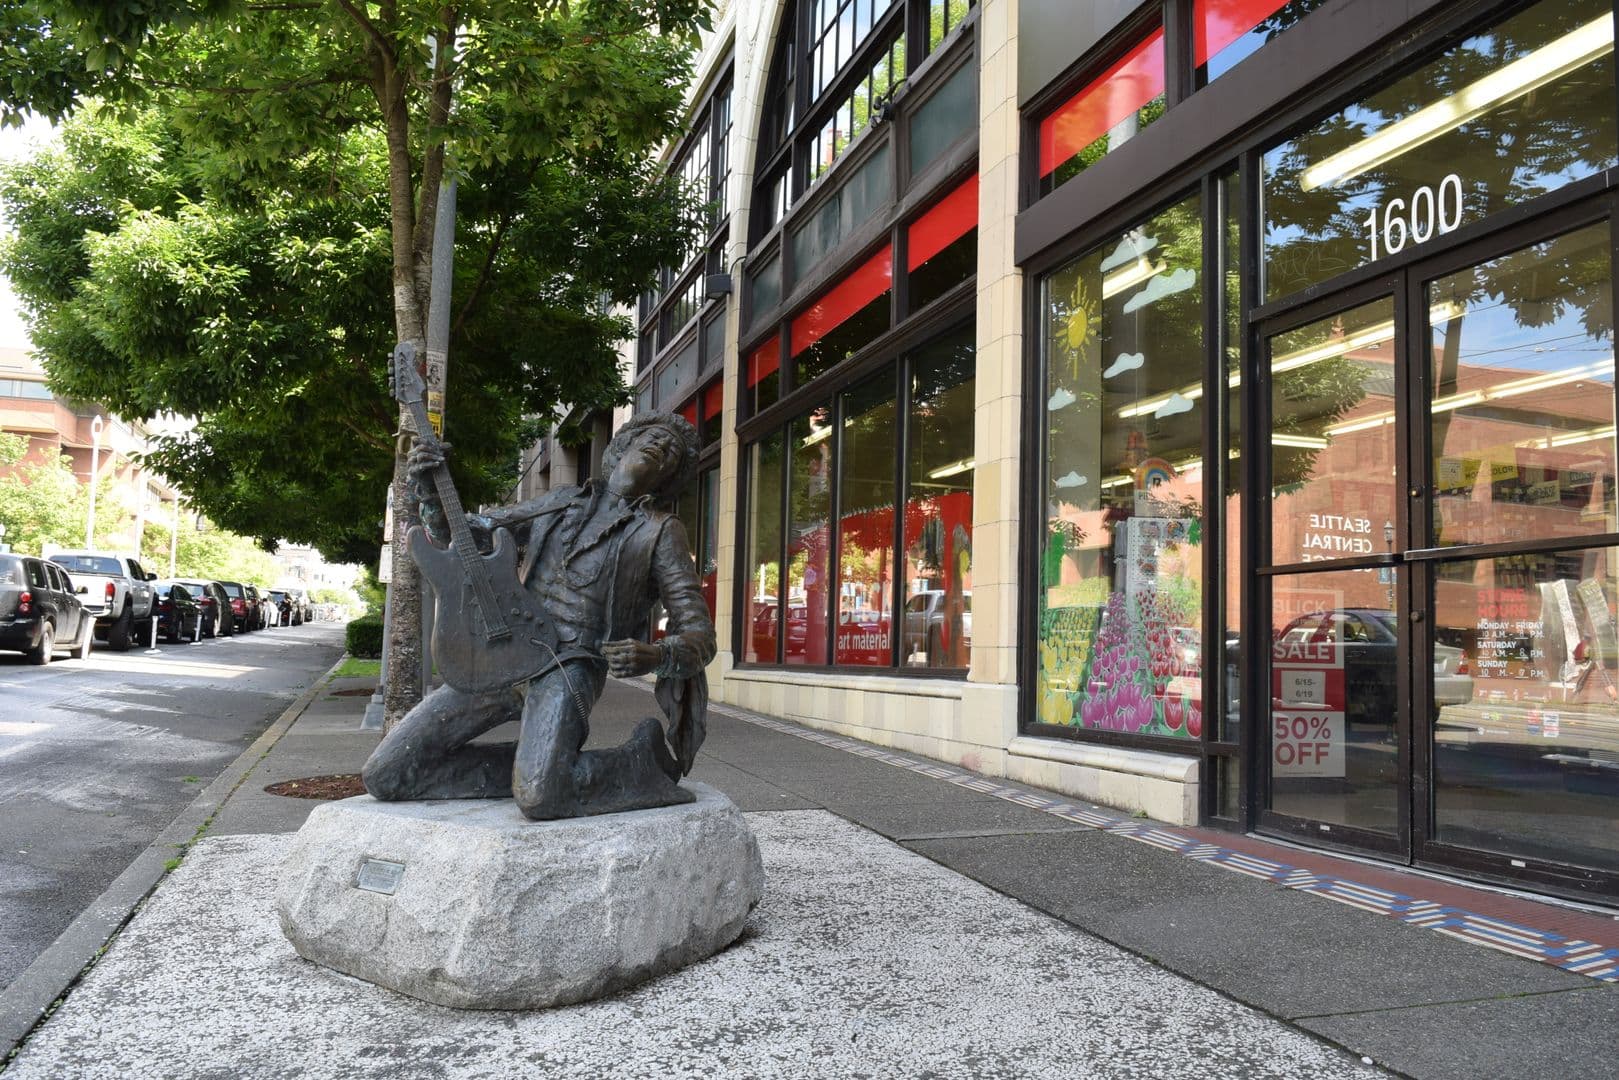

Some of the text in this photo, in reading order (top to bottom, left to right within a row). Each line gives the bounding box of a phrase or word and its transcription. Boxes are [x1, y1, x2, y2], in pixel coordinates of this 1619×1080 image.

[1363, 173, 1463, 262] 1600
[1477, 621, 1510, 630] MONDAY
[1515, 621, 1544, 630] FRIDAY
[838, 628, 890, 650] art material
[1477, 641, 1517, 649] SATURDAY
[1273, 640, 1330, 660] SALE
[1477, 660, 1508, 668] SUNDAY
[1274, 716, 1332, 740] 50%
[1274, 742, 1330, 766] OFF
